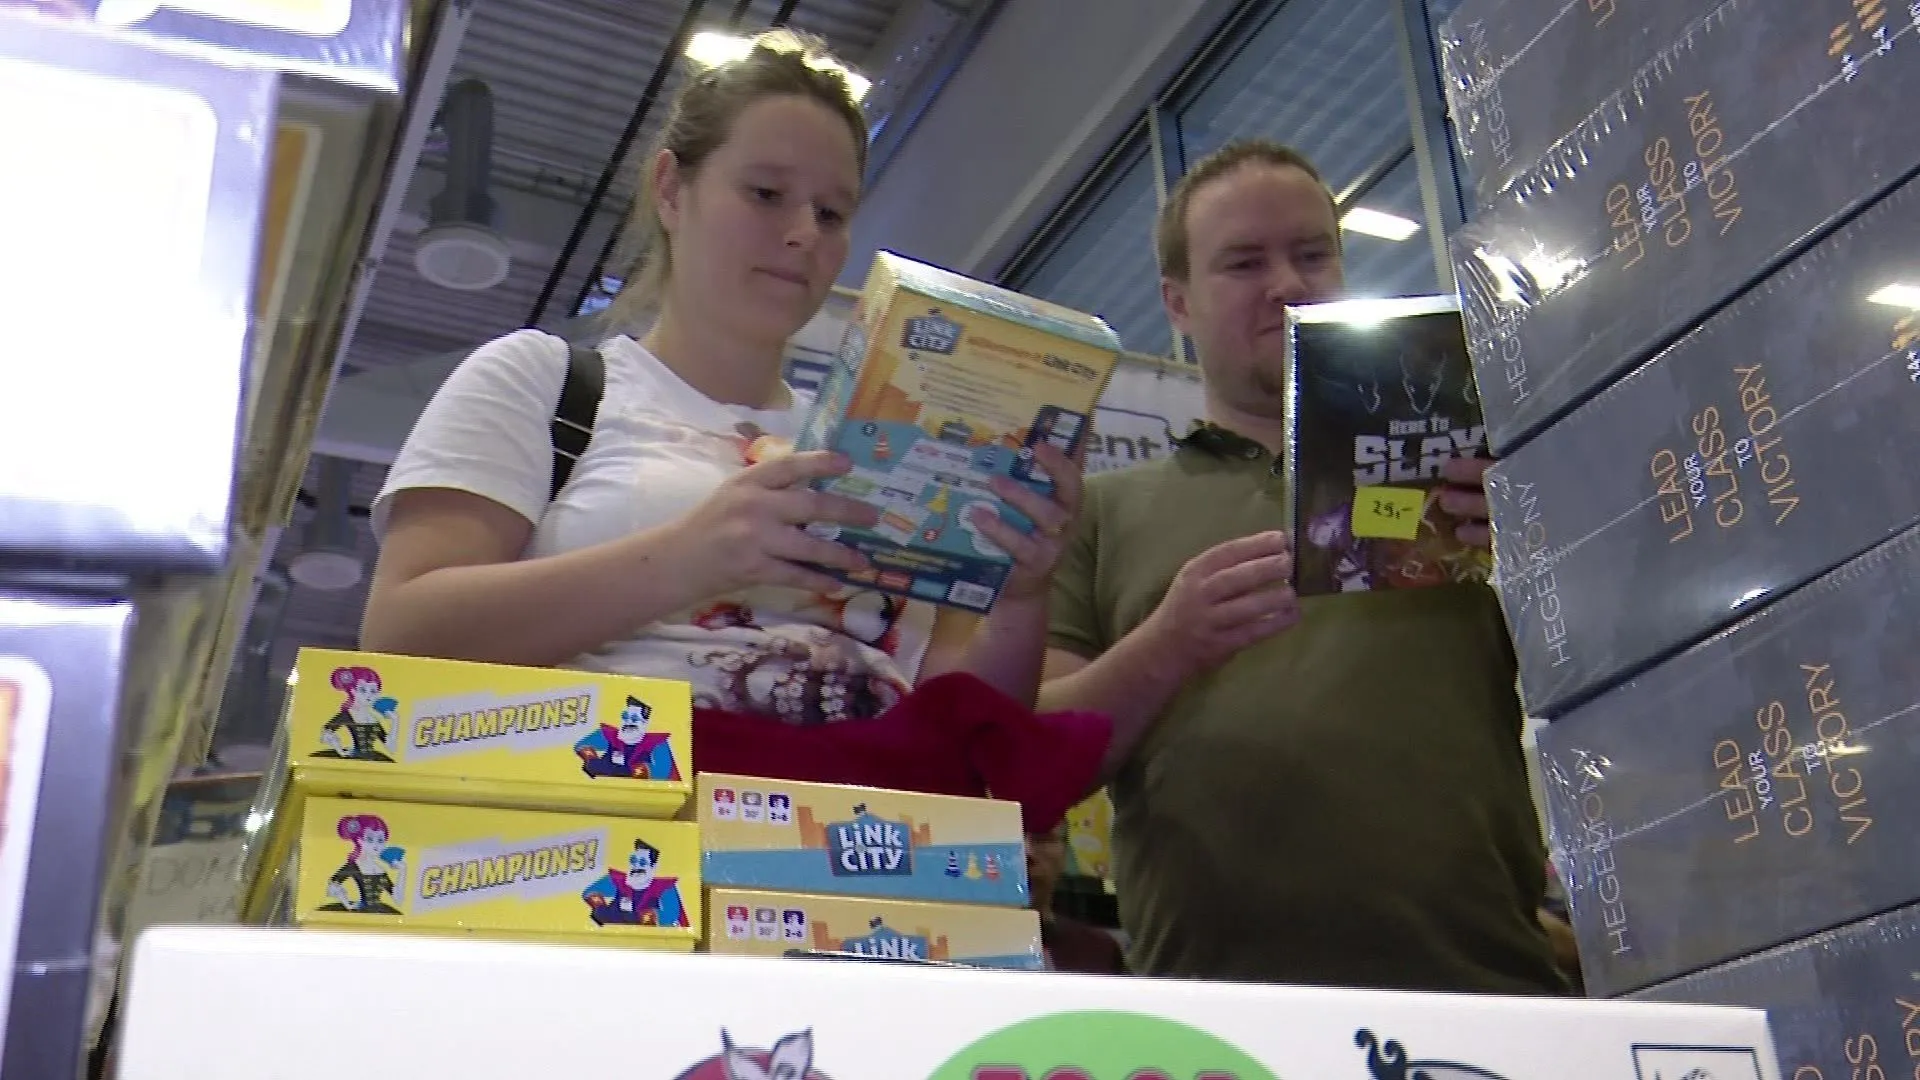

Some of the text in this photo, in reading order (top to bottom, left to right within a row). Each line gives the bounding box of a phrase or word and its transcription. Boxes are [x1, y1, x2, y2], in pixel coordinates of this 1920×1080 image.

[1645, 136, 1691, 248] CLASS
[1684, 90, 1743, 237] VICTORY
[1604, 183, 1646, 271] LEAD
[1353, 425, 1484, 487] SLAY
[1684, 452, 1706, 509] YOUR
[1692, 406, 1744, 528] CLASS
[1733, 363, 1800, 526] VICTORY
[1734, 437, 1753, 468] TO
[1650, 448, 1693, 544] LEAD
[1515, 482, 1571, 668] HEGEMONY
[414, 694, 591, 749] CHAMPIONS!
[1757, 701, 1813, 836] CLASS
[1800, 663, 1873, 845] VICTORY
[1713, 739, 1760, 844] LEAD
[1748, 748, 1774, 811] YOUR
[420, 838, 599, 900] CHAMPIONS!
